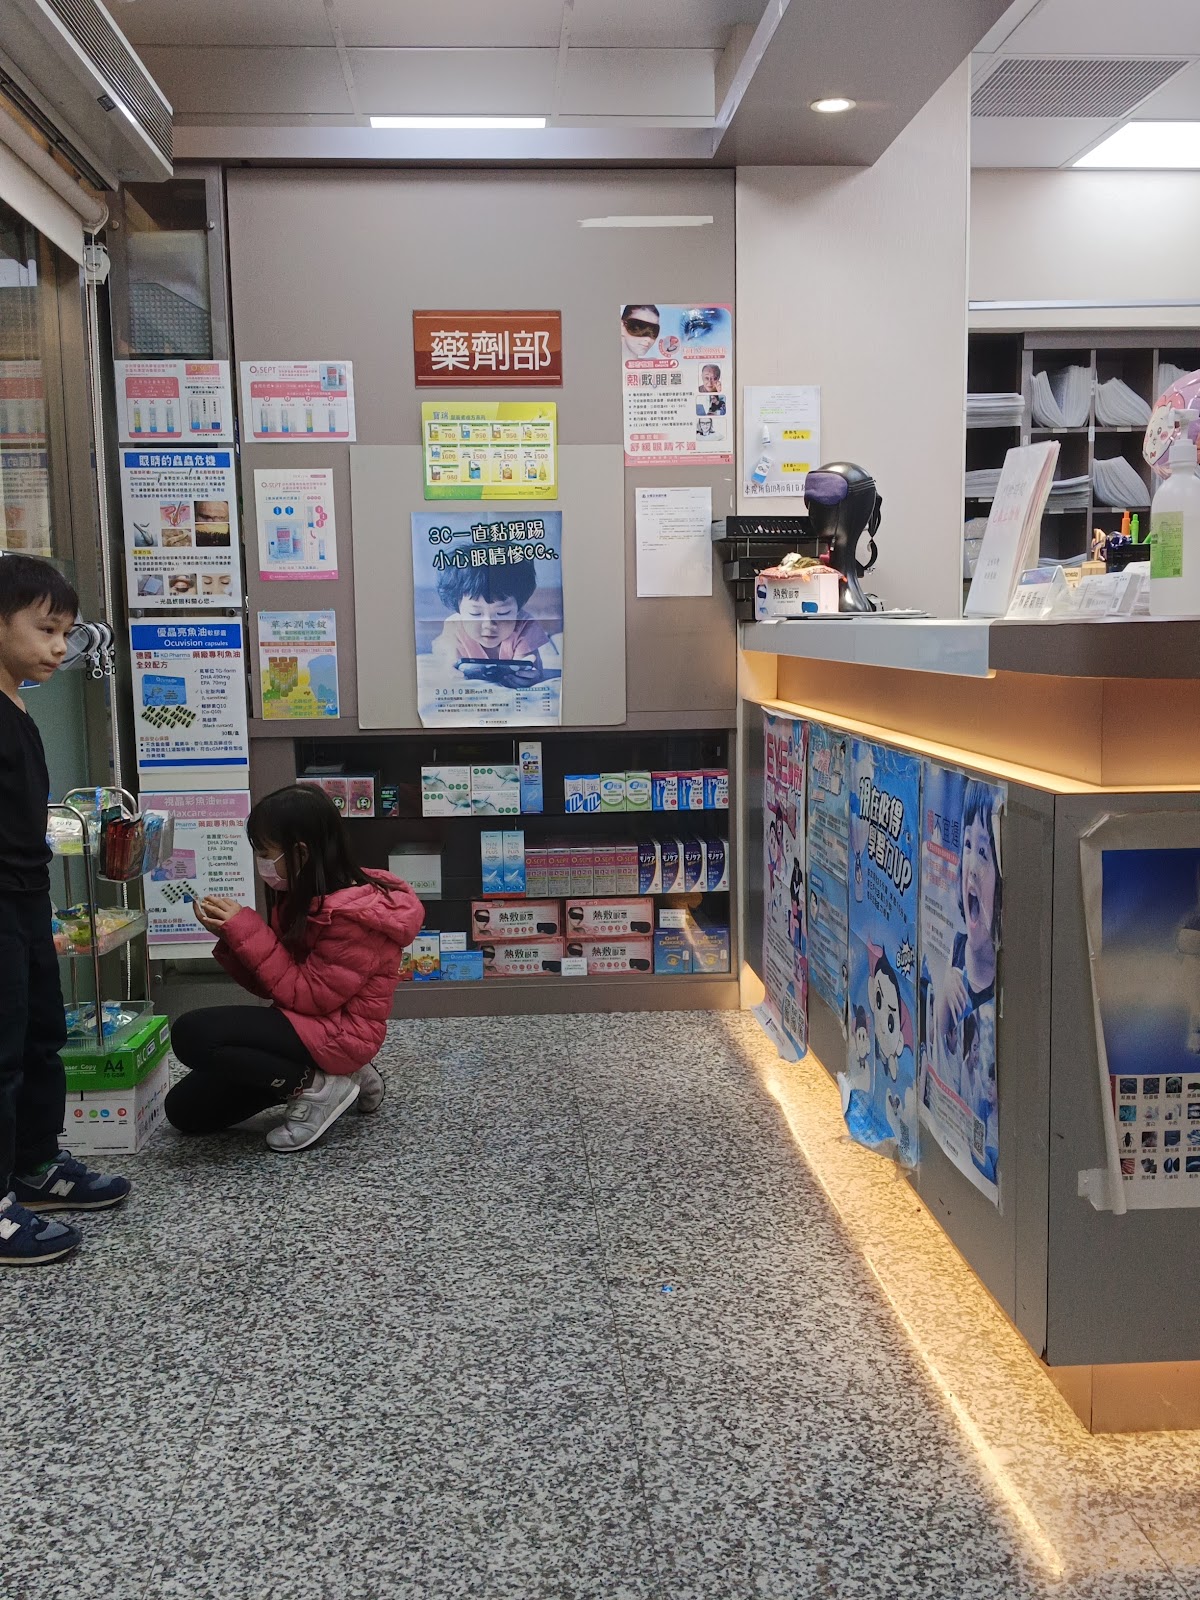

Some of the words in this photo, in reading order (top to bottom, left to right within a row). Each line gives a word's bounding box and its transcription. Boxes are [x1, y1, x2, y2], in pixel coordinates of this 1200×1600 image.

[430, 330, 551, 370] 藥劑部
[627, 373, 682, 386] 熱敷眼罩
[139, 455, 216, 467] 眼睛的蟲蟲危機
[428, 518, 546, 545] 3C一直黏踢踢
[164, 639, 203, 647] Ocuvision
[204, 640, 229, 648] capsules
[136, 661, 168, 669] 全效配方
[499, 911, 534, 923] 熱敷眼罩
[593, 909, 628, 921] 熱敷眼罩
[504, 948, 539, 960] 熱敷眼罩
[592, 946, 627, 957] 熱敷眼罩
[104, 1059, 124, 1073] A4
[49, 1178, 76, 1197] N
